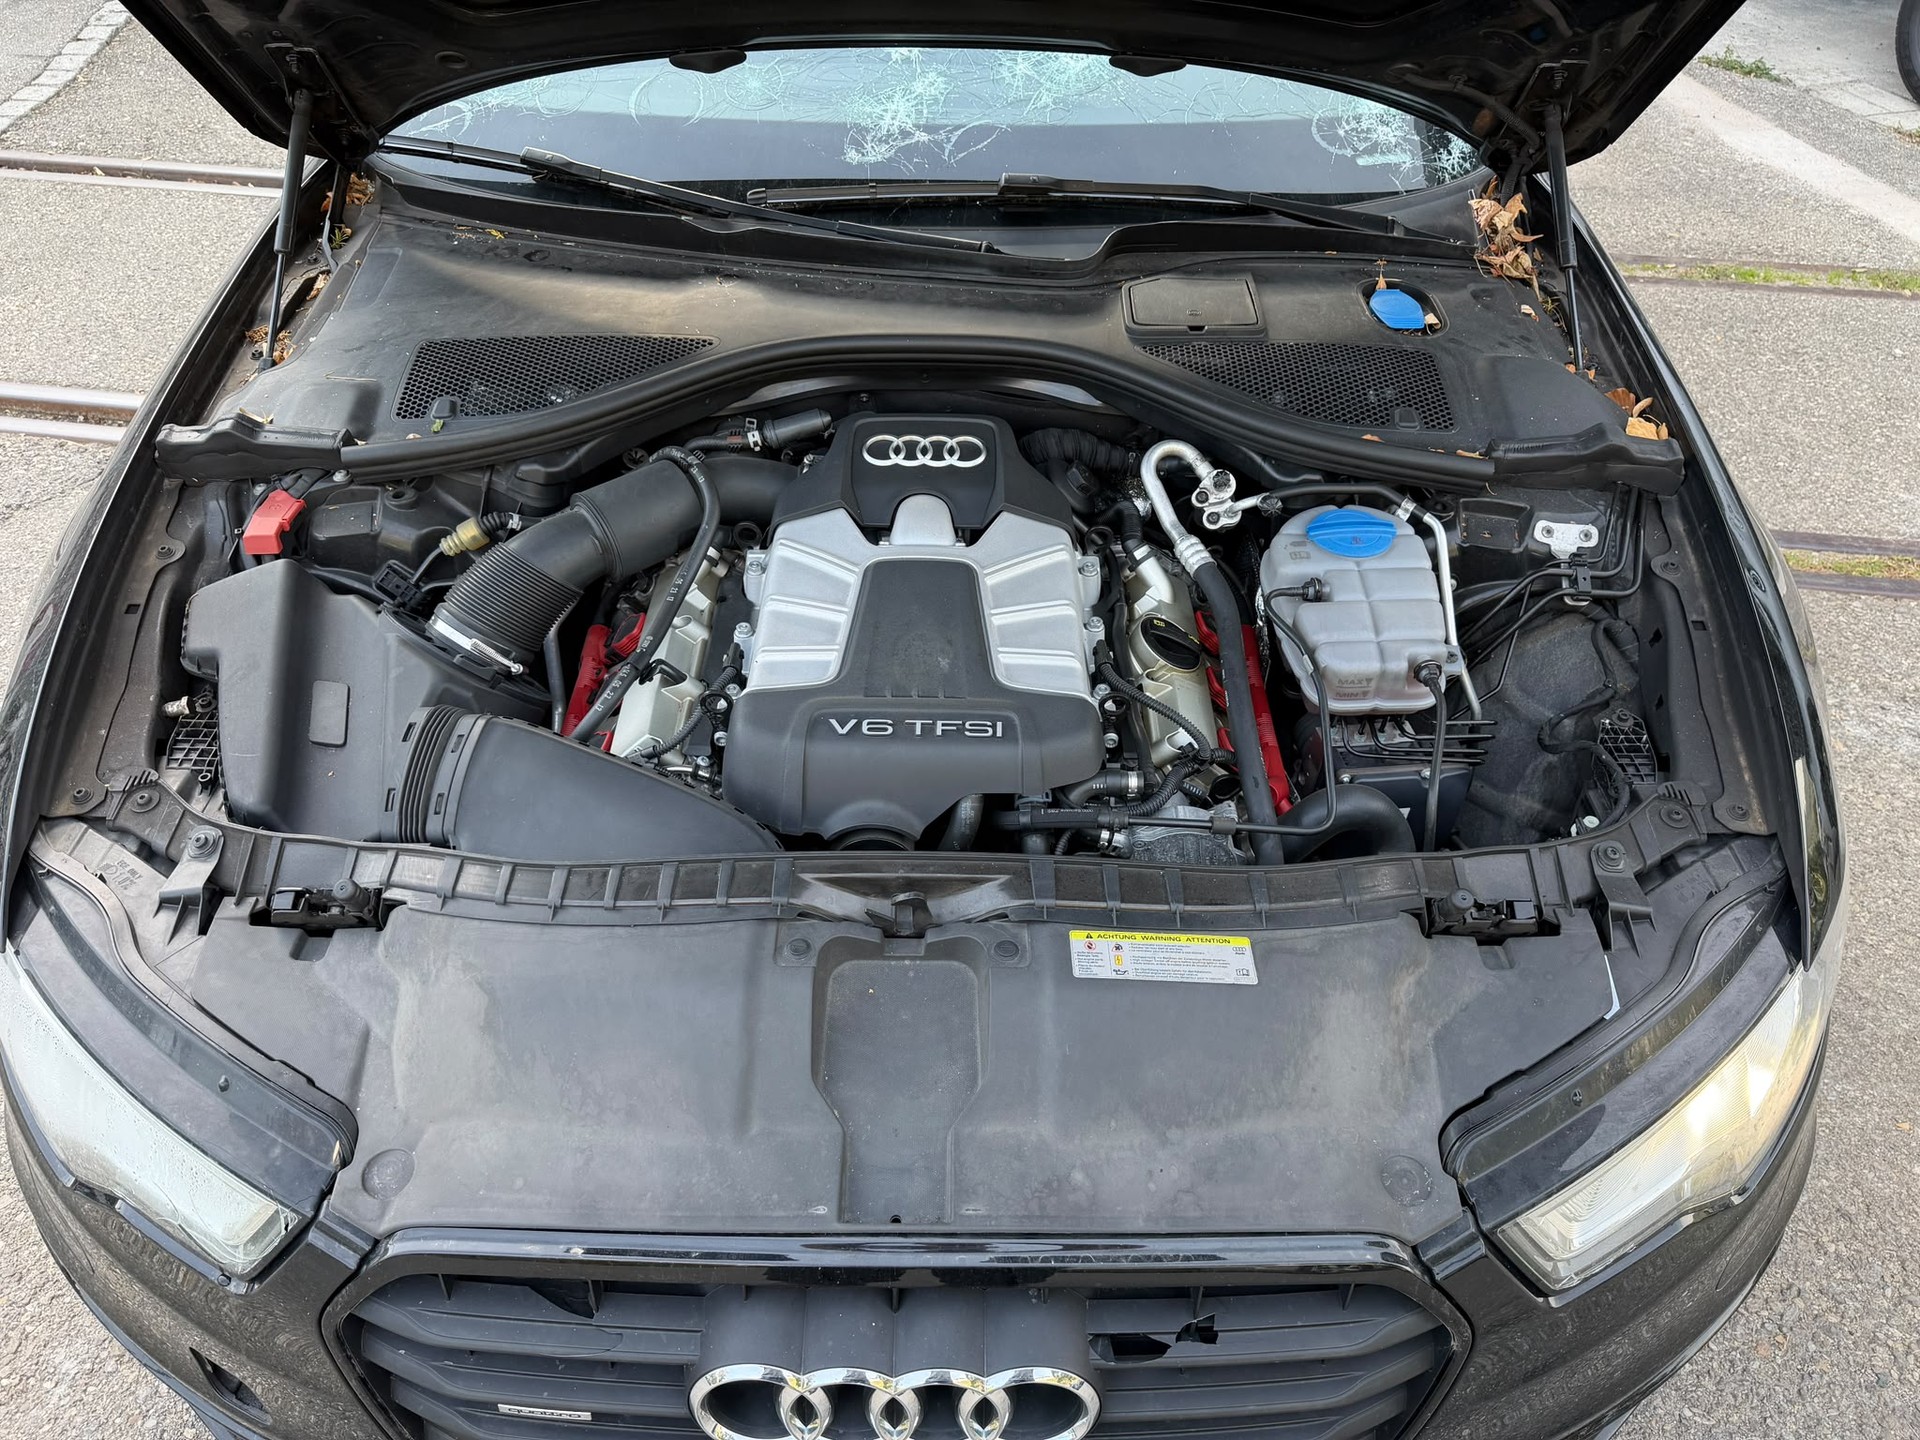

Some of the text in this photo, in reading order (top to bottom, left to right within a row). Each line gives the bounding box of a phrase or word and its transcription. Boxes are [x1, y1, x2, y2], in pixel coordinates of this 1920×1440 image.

[828, 718, 1003, 737] V6 TFSI
[508, 1408, 581, 1418] quattro
